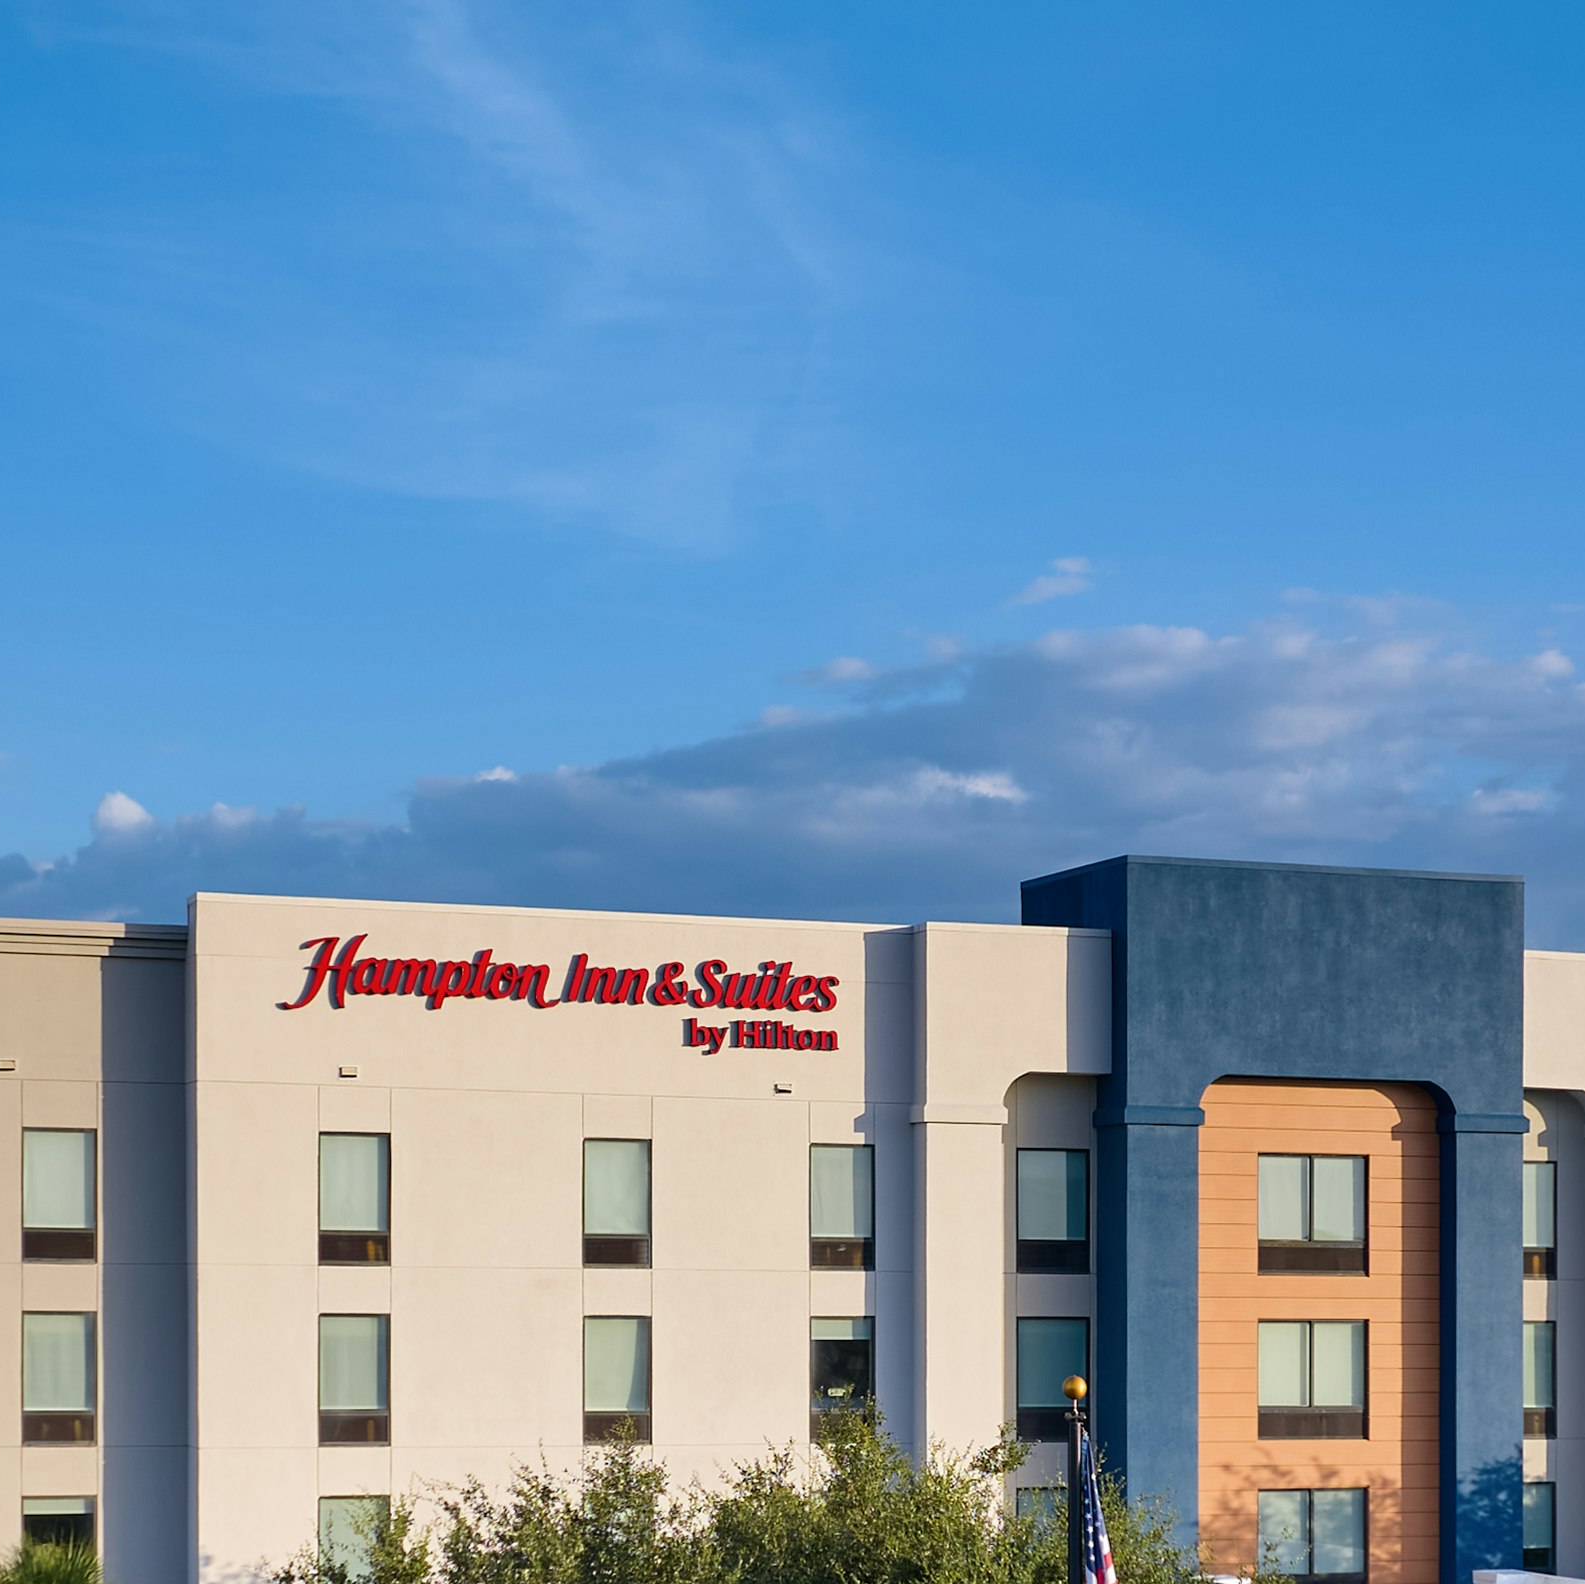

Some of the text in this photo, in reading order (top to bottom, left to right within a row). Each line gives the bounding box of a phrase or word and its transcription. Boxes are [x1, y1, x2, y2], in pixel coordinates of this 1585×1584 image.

[277, 933, 840, 1011] Hampton Inn & Suites
[683, 1017, 839, 1055] by Hilton
